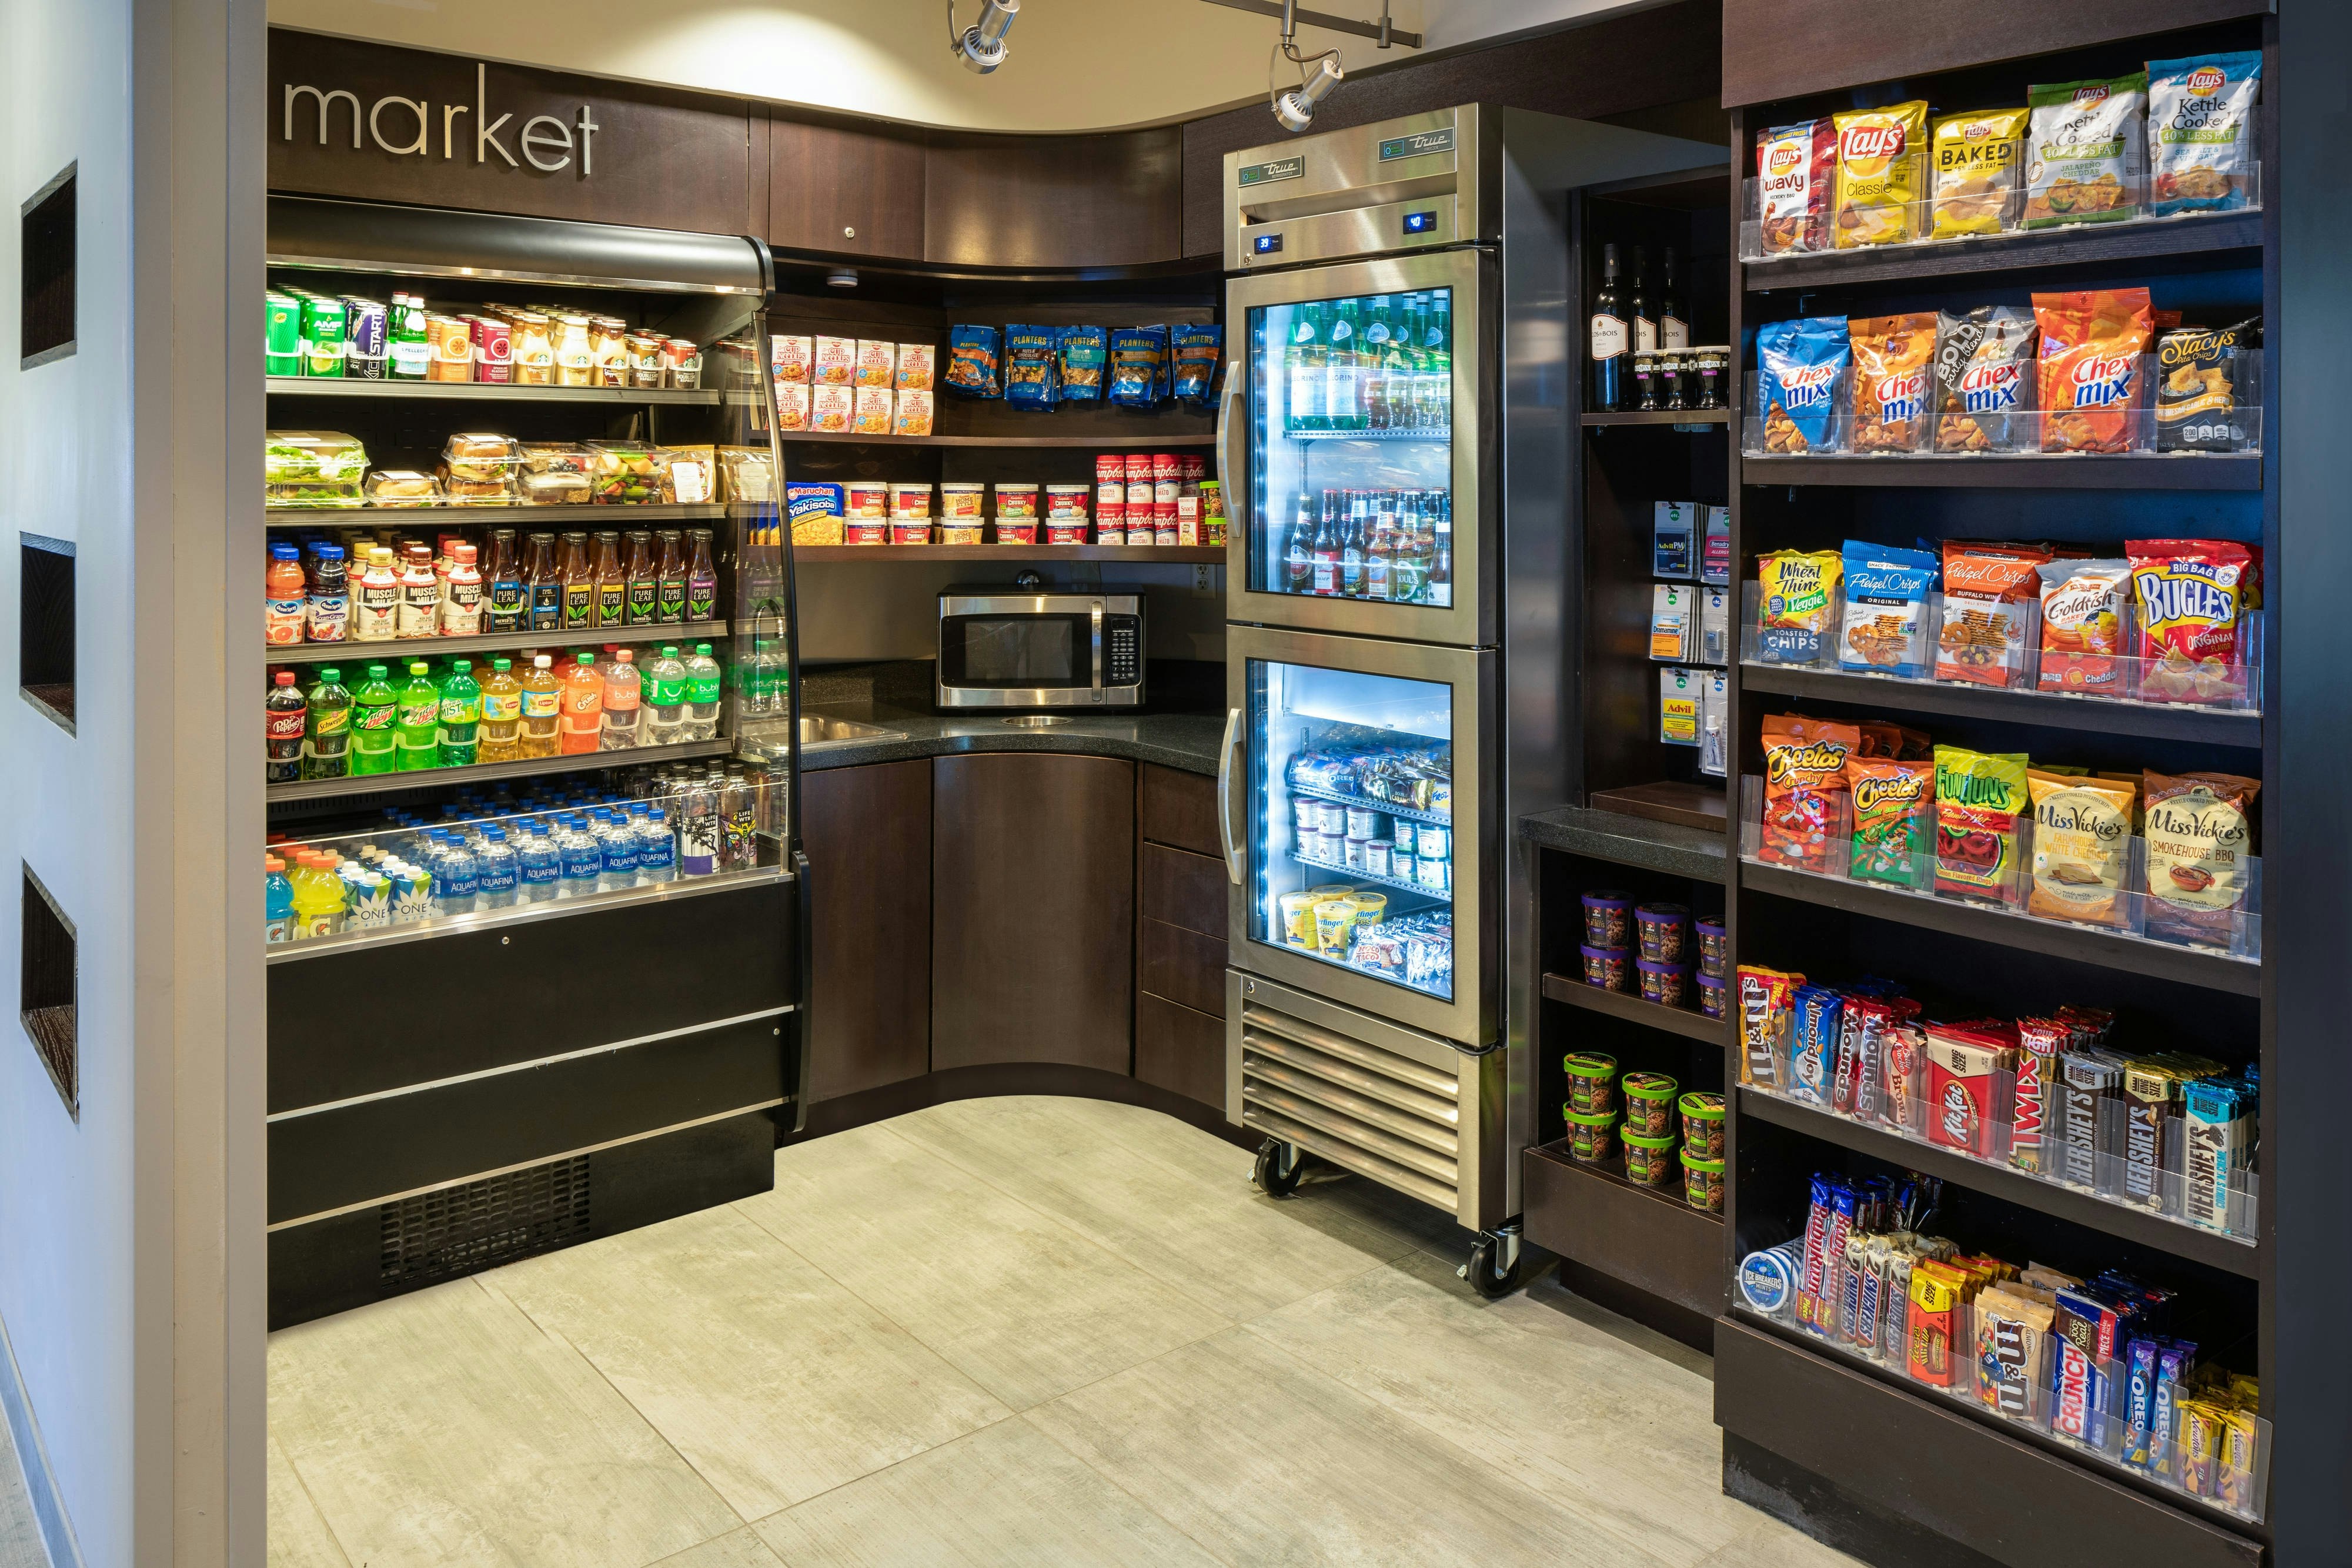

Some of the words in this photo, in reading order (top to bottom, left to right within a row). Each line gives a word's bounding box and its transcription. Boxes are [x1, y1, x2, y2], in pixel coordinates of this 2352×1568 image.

[2190, 71, 2223, 88] Lay's
[2179, 98, 2227, 114] Kettle
[285, 63, 599, 176] market
[2172, 113, 2231, 130] Cooked
[1843, 126, 1903, 161] Lay's
[2163, 131, 2184, 141] 40%
[2187, 131, 2210, 139] LESS
[2212, 131, 2234, 139] FAT
[1771, 148, 1801, 168] Lay's
[1942, 143, 2011, 165] BAKED
[2063, 168, 2100, 177] CHEDDAR
[1765, 175, 1804, 191] wavy
[1847, 181, 1892, 196] Classic
[1411, 216, 1420, 227] 40
[1260, 238, 1268, 248] 39
[1013, 337, 1047, 345] PLANTERS
[1064, 337, 1100, 347] PLANTERS
[1120, 339, 1155, 348] PLANTERS
[2161, 332, 2236, 364] Stacy's
[1938, 324, 1975, 379] BOLD
[2106, 349, 2129, 358] SAVORY
[2177, 355, 2190, 363] Pita
[2193, 351, 2211, 360] Chips
[863, 356, 889, 365] NOODLES
[1993, 357, 2014, 365] SAVORY
[1782, 360, 1835, 387] Chex
[1963, 362, 2020, 389] Chex
[2074, 356, 2132, 383] Chex
[1788, 383, 1829, 409] mix
[1967, 382, 2017, 412] mix
[795, 487, 834, 495] Maruchan
[789, 500, 835, 516] Yakisoba
[956, 497, 974, 505] HOME
[1780, 561, 1822, 580] Wheat
[1945, 561, 1986, 580] Pretzel
[1987, 563, 2031, 583] Crisps
[2173, 563, 2188, 573] BIG
[2190, 566, 2213, 577] BAG
[410, 586, 437, 596] MUSCLE
[455, 584, 482, 594] MUSCLE
[1782, 579, 1820, 593] Thins
[1850, 574, 1888, 591] Pretzel
[1889, 574, 1921, 594] Crisps
[367, 589, 396, 599] MUSCLE
[461, 594, 478, 603] MILK
[1957, 590, 1986, 599] BUFFALO
[2139, 574, 2233, 626] BUGLES
[1790, 594, 1823, 612] Veggie
[2049, 590, 2112, 619] Goldfish
[2060, 613, 2085, 622] BAKED
[1768, 636, 1819, 649] CHIPS
[2211, 643, 2231, 652] FLAVOR
[577, 693, 597, 710] Crush
[614, 690, 638, 698] bubly
[440, 704, 462, 717] MIST
[1668, 704, 1691, 713] Advil
[276, 720, 299, 733] Pepper
[319, 714, 346, 730] Schweppes
[1768, 742, 1844, 783] Cheetos
[1783, 773, 1822, 788] Crunchy
[1936, 765, 2012, 810] FUNYUNS
[1855, 775, 1922, 810] Cheetos
[1858, 808, 1883, 821] Cheddar
[1885, 802, 1915, 815] Jalapeño
[2037, 805, 2074, 828] Miss
[2070, 807, 2122, 841] Vickie's
[2149, 809, 2192, 835] Miss
[2188, 812, 2244, 845] Vickie's
[2054, 833, 2097, 848] FARMHOUSE
[640, 852, 669, 863] AQUAFINA
[2044, 842, 2069, 854] WHITE
[2073, 848, 2108, 861] CHEDDAR
[2153, 840, 2210, 859] SMOKEHOUSE
[2216, 850, 2234, 861] BBQ
[609, 855, 638, 867] AQUAFINA
[527, 867, 559, 878] AQUAFINA
[1953, 871, 1975, 881] Flavored
[1977, 877, 1991, 885] Rings
[480, 875, 513, 888] AQUAFINA
[360, 909, 386, 920] ONE
[401, 903, 427, 915] ONE
[1806, 999, 1821, 1061] Almond
[2032, 1028, 2053, 1037] FOUR
[1836, 1009, 1859, 1102] Mounds
[1802, 1056, 1818, 1086] Joy
[2009, 1057, 2042, 1156] TWIX
[2067, 1090, 2093, 1185] HERSHEY'S
[2127, 1106, 2155, 1196] HERSHEY'S
[2188, 1126, 2215, 1221] HERSHEY'S
[1755, 1274, 1782, 1289] BREAKERS
[1756, 1283, 1772, 1292] MINTS
[1859, 1272, 1880, 1342] SNICKERS
[2077, 1321, 2087, 1347] Real
[2060, 1345, 2084, 1434] CRUNCH
[2131, 1376, 2144, 1432] OREO
[2158, 1385, 2170, 1440] OREO
[2191, 1415, 2201, 1459] Newtons
